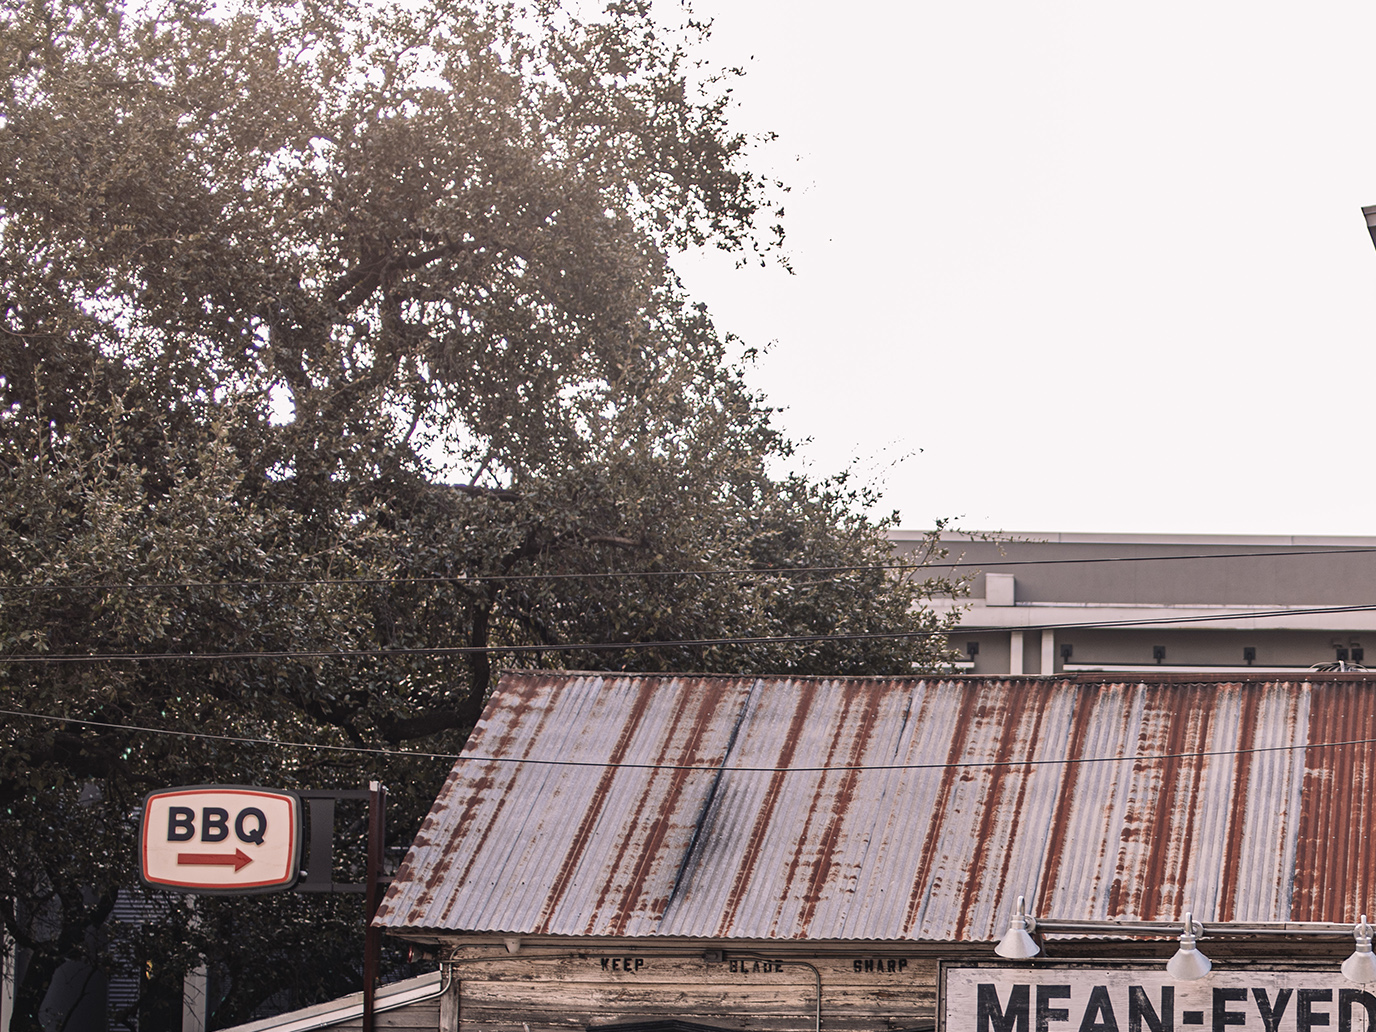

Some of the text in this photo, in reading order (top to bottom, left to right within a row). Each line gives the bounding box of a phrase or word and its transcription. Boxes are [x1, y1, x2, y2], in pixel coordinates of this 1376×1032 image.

[167, 806, 268, 846] BBQ
[600, 957, 645, 972] KEEP
[729, 959, 785, 974] BLADE
[853, 958, 908, 974] SHARP
